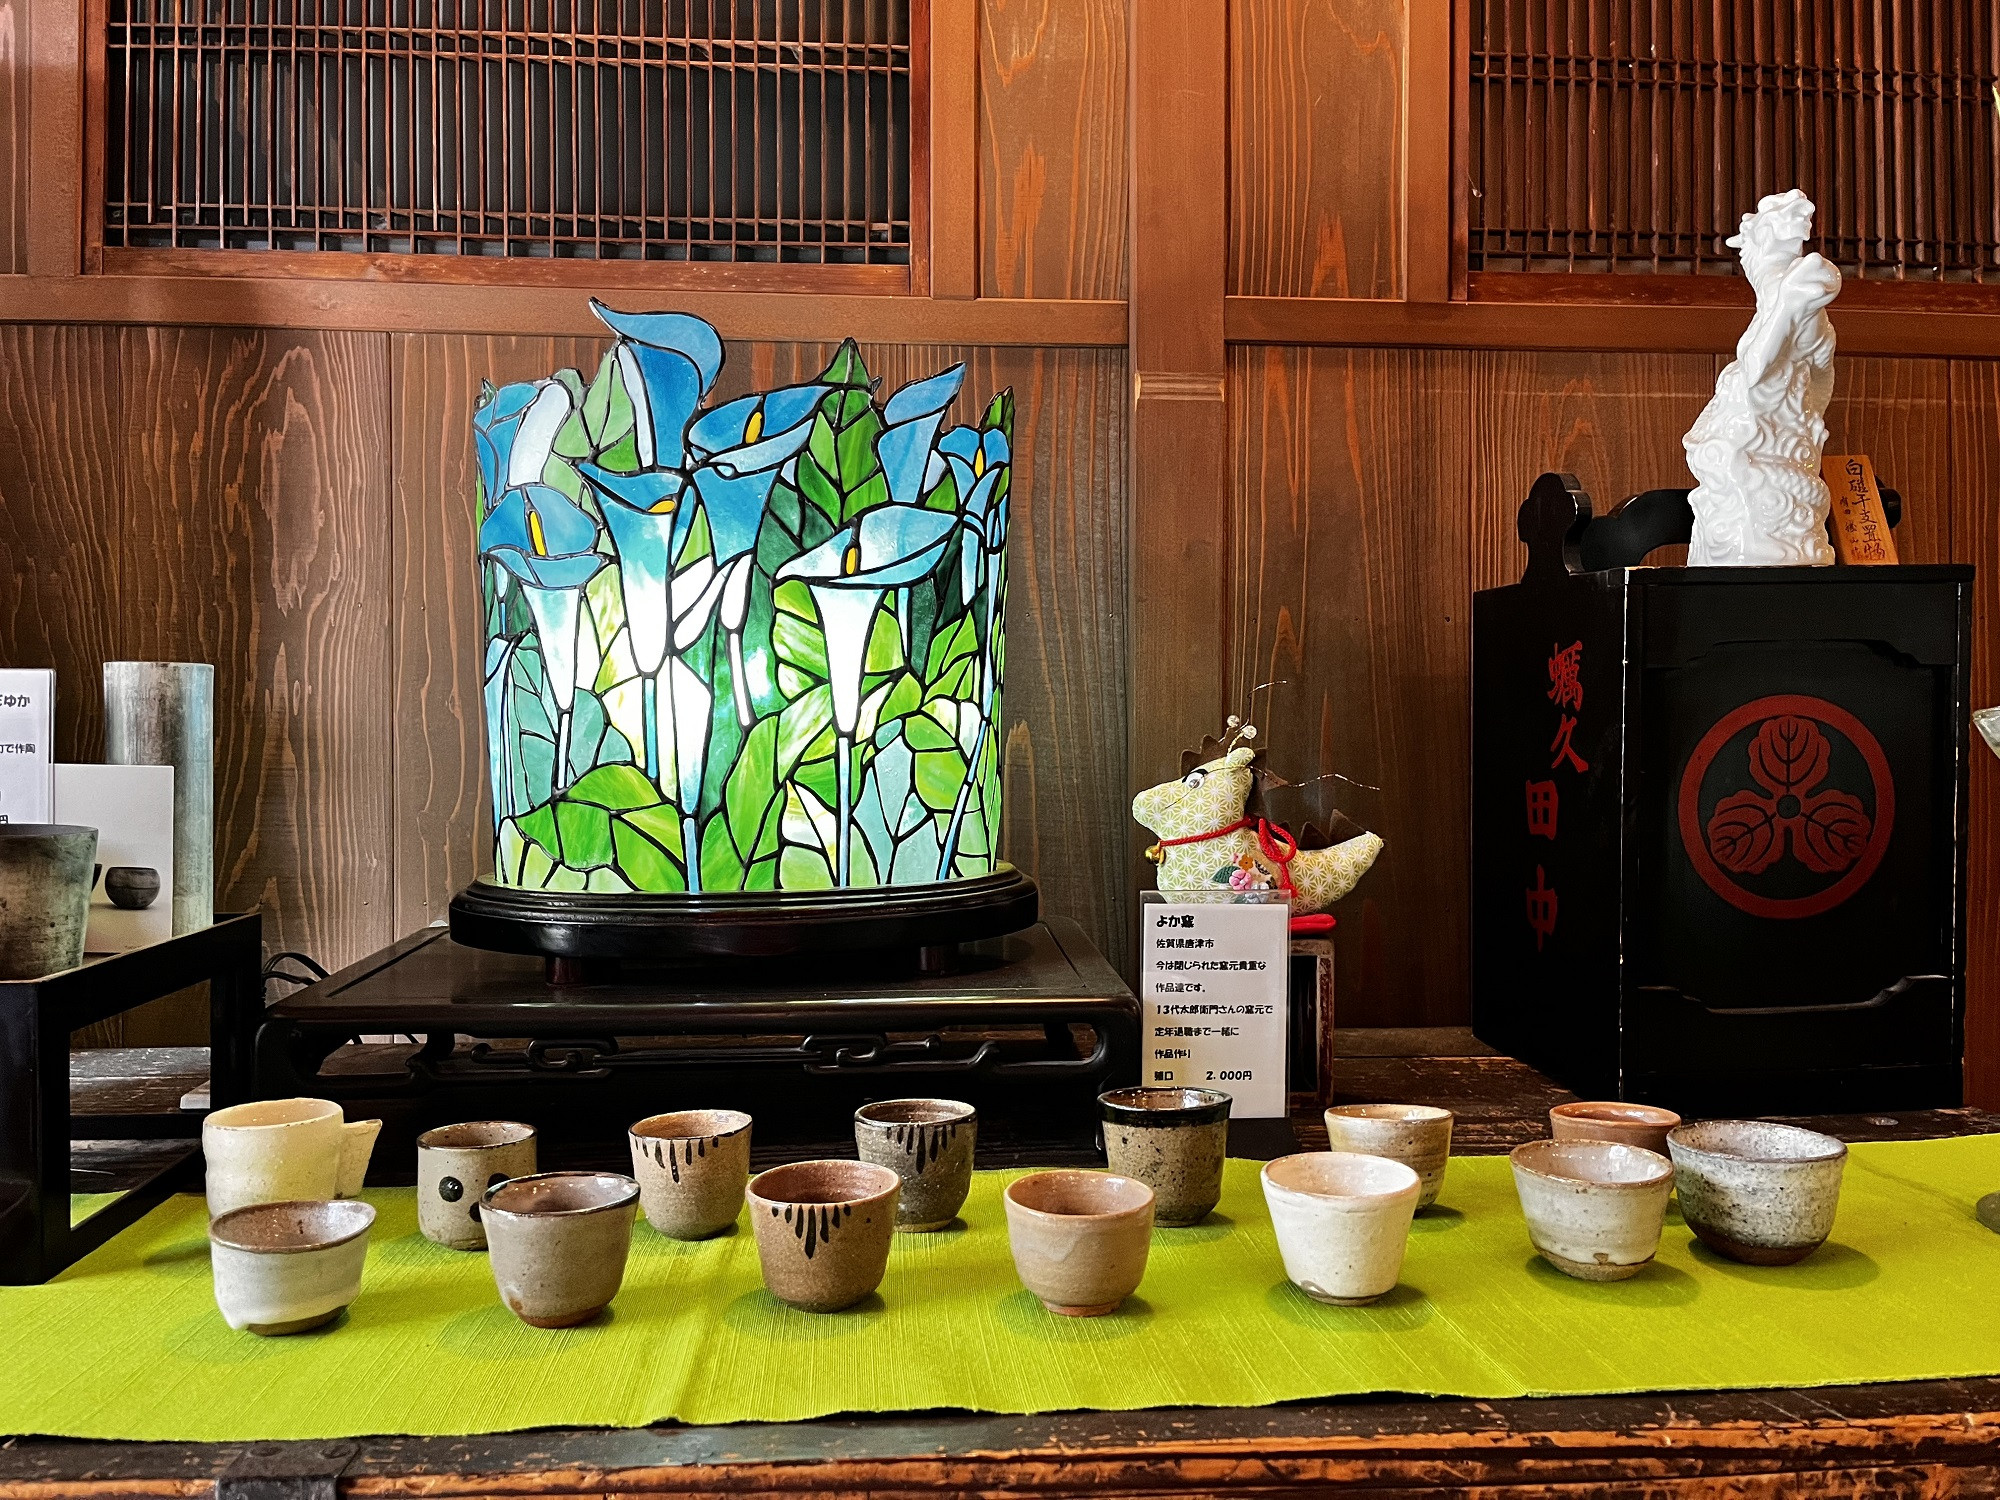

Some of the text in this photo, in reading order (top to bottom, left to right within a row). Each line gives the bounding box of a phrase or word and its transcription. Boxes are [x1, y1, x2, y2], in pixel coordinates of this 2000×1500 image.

[0, 694, 31, 708] ゆか
[1156, 915, 1195, 928] よか窯
[1156, 938, 1215, 949] 佐賀県唐津市
[1155, 961, 1267, 971] 今は閉じられた窯元貴重な
[1154, 1027, 1240, 1037] 定年退職まで一緒に
[1154, 1049, 1191, 1060] 作品作り
